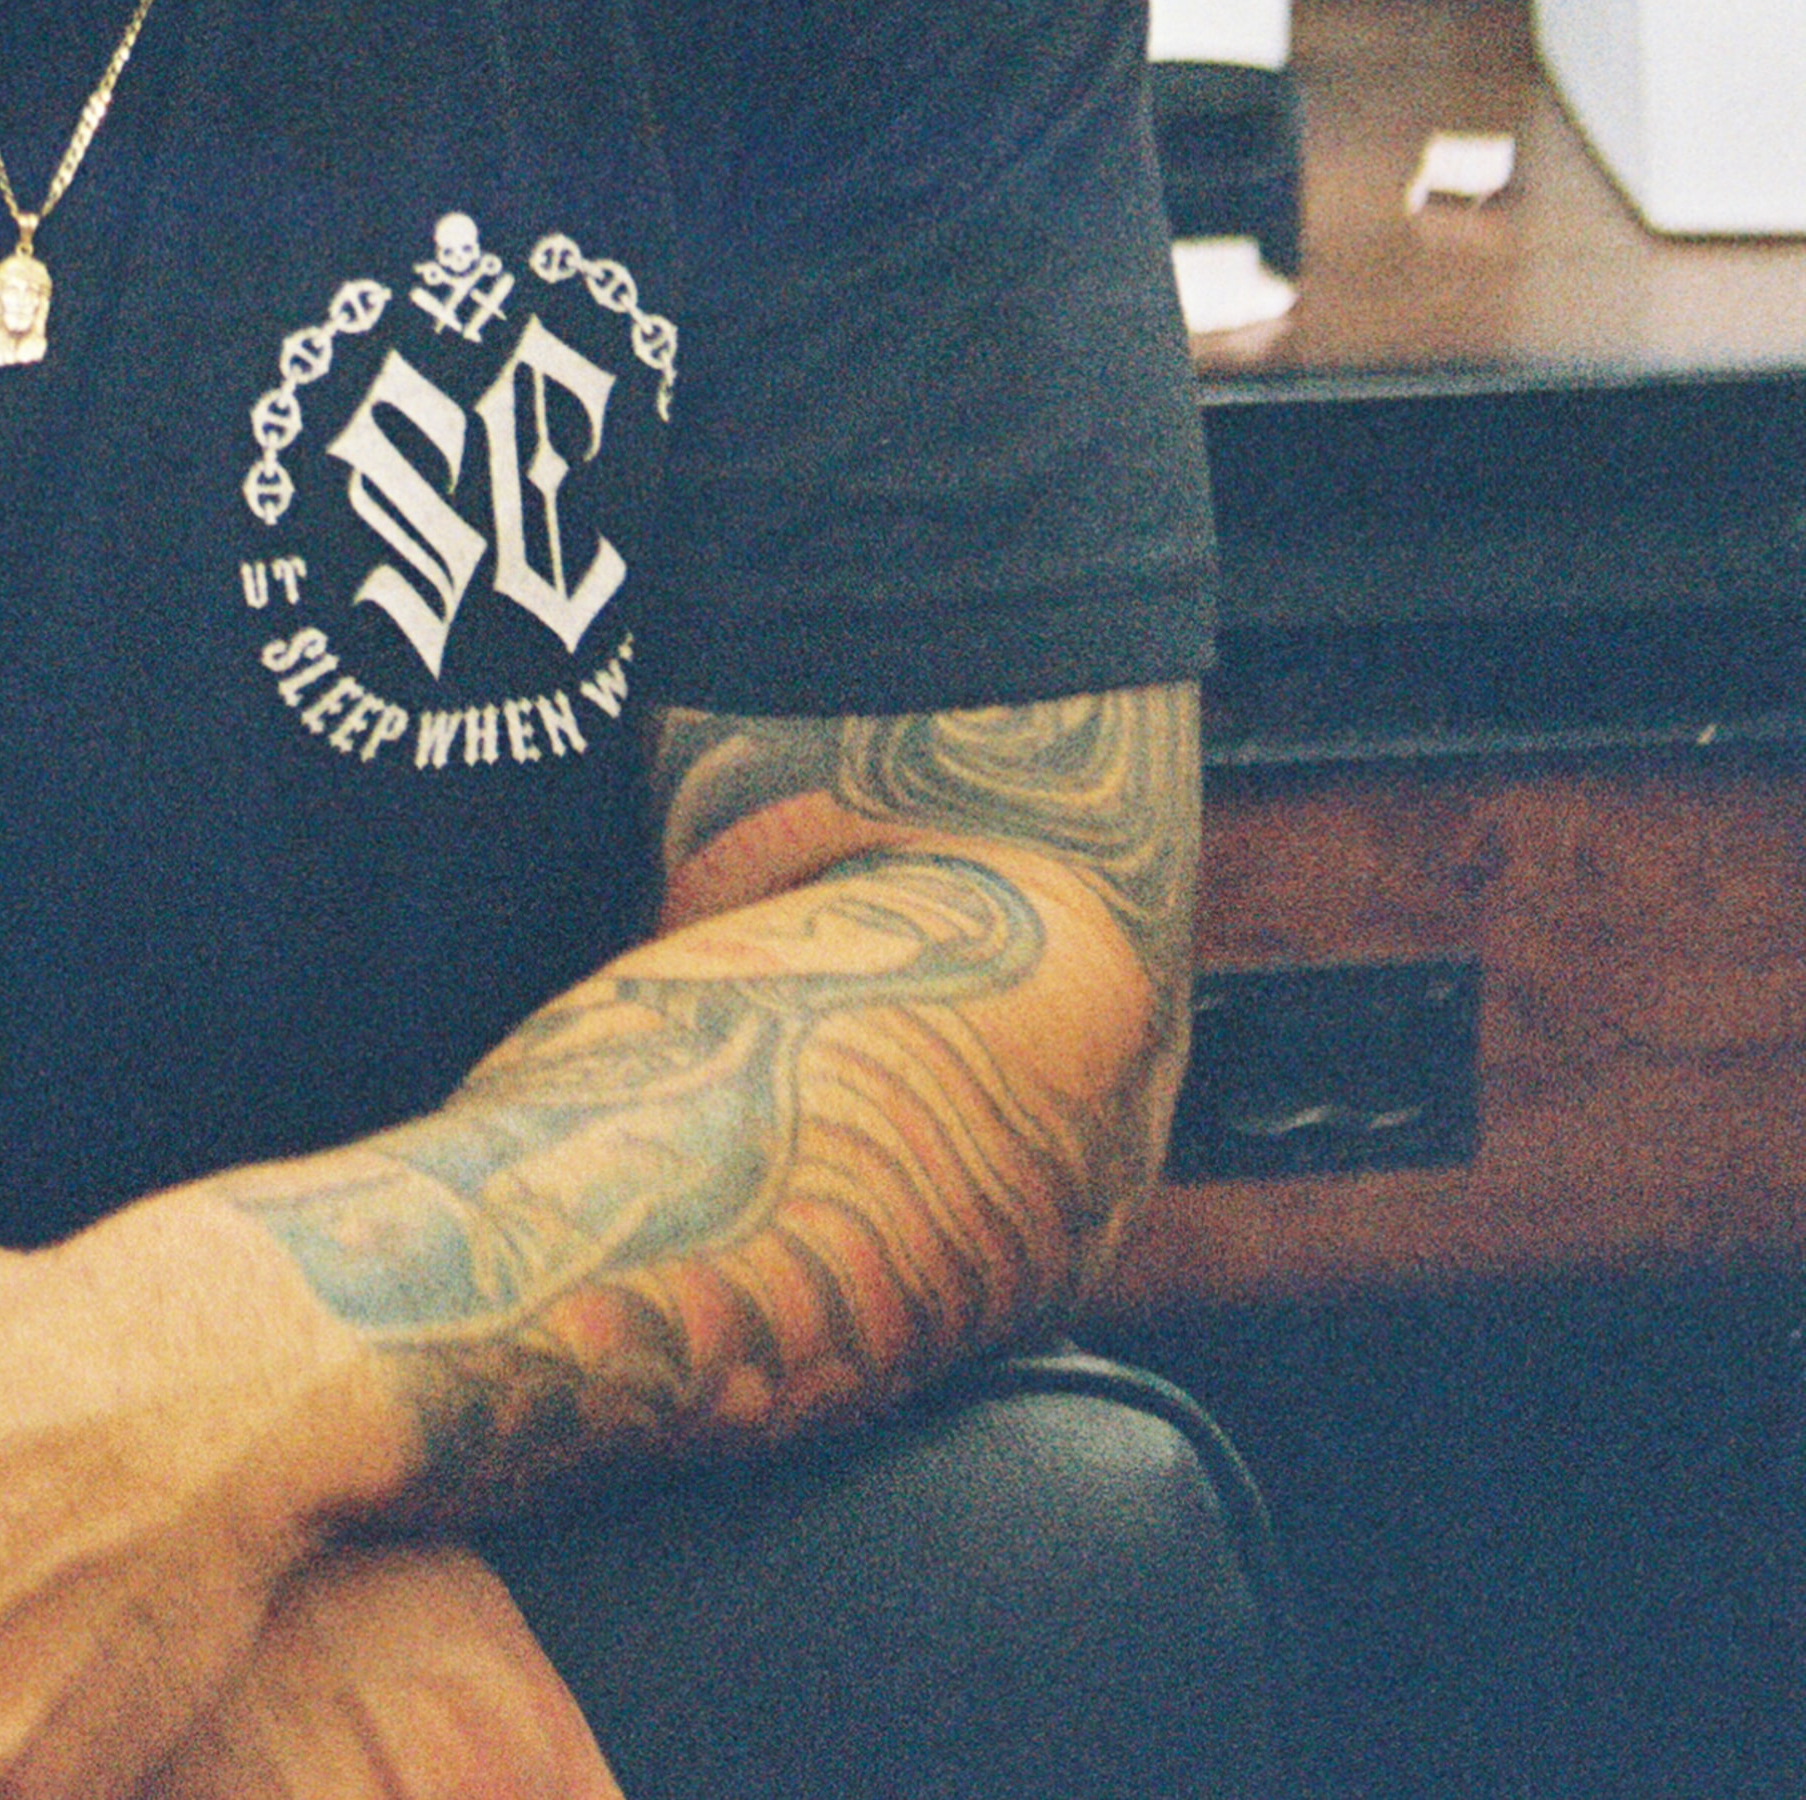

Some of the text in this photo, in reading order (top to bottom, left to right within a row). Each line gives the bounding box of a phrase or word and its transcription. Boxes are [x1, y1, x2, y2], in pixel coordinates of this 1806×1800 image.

[240, 555, 308, 610] UT
[260, 626, 410, 763] SLEEP
[415, 689, 588, 770] WHEN
